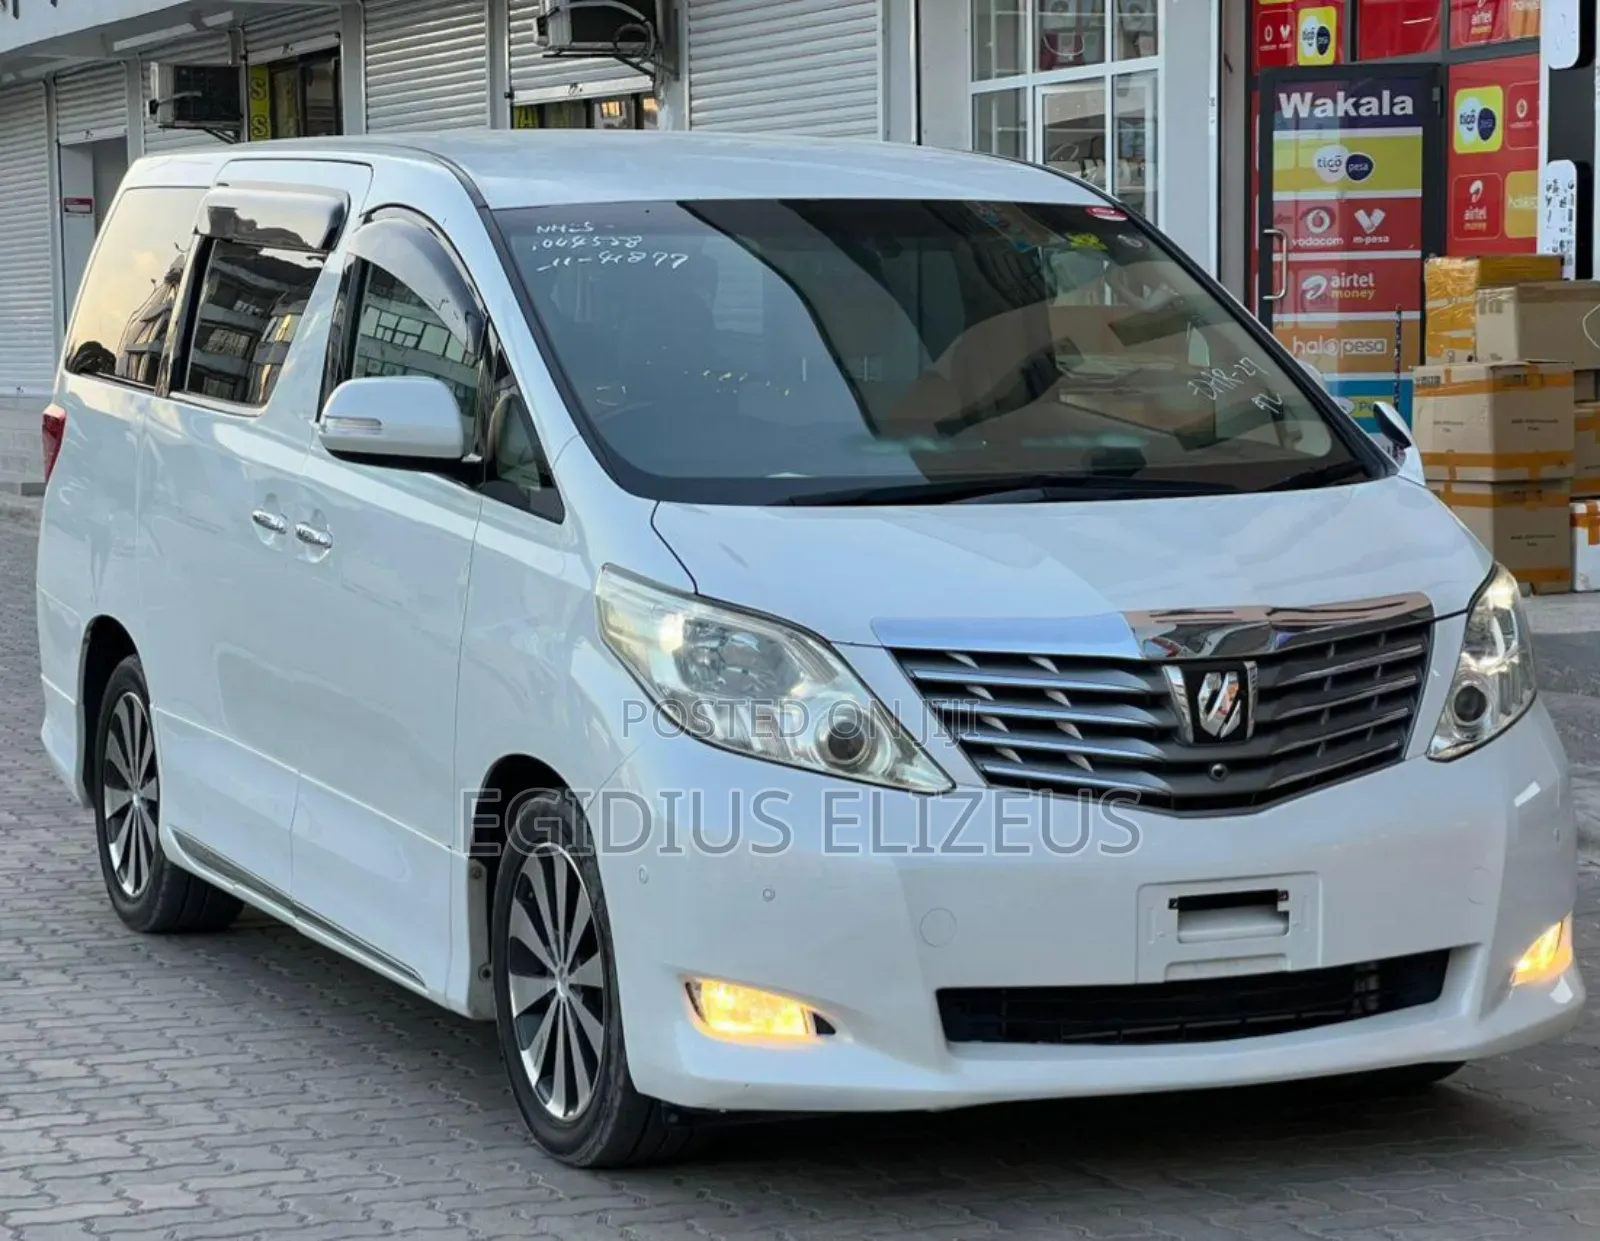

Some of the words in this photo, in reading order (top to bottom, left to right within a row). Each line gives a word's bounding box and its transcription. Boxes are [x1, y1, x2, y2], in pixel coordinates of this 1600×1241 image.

[1278, 89, 1414, 119] Wakala
[1348, 162, 1369, 173] pesa
[1292, 235, 1344, 249] vodacom
[1330, 271, 1375, 288] airtel
[1330, 288, 1376, 300] money
